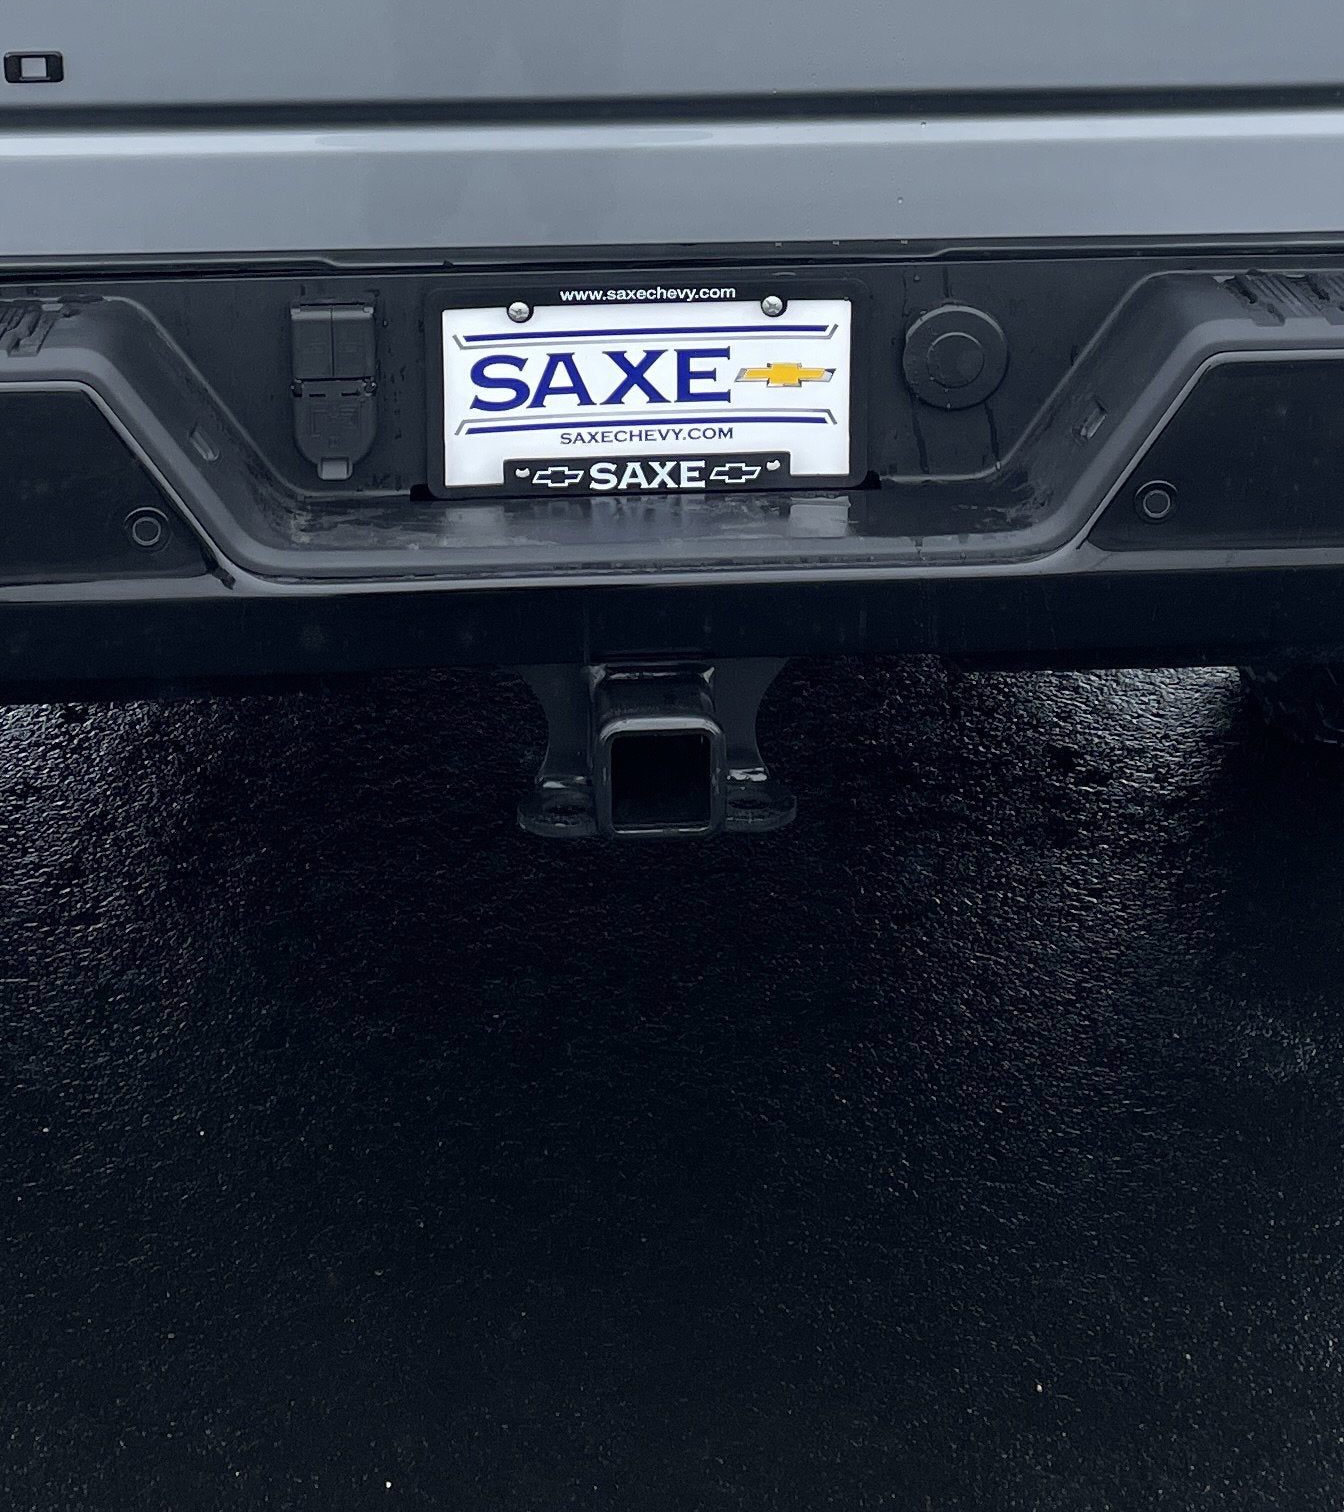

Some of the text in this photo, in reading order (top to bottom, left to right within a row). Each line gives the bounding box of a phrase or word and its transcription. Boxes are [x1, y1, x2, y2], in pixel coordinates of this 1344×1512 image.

[560, 286, 736, 302] www.saxechevy.com
[469, 346, 731, 412] SAXE
[560, 427, 734, 445] SAXECHEVY.COM
[589, 460, 706, 489] SAXE
